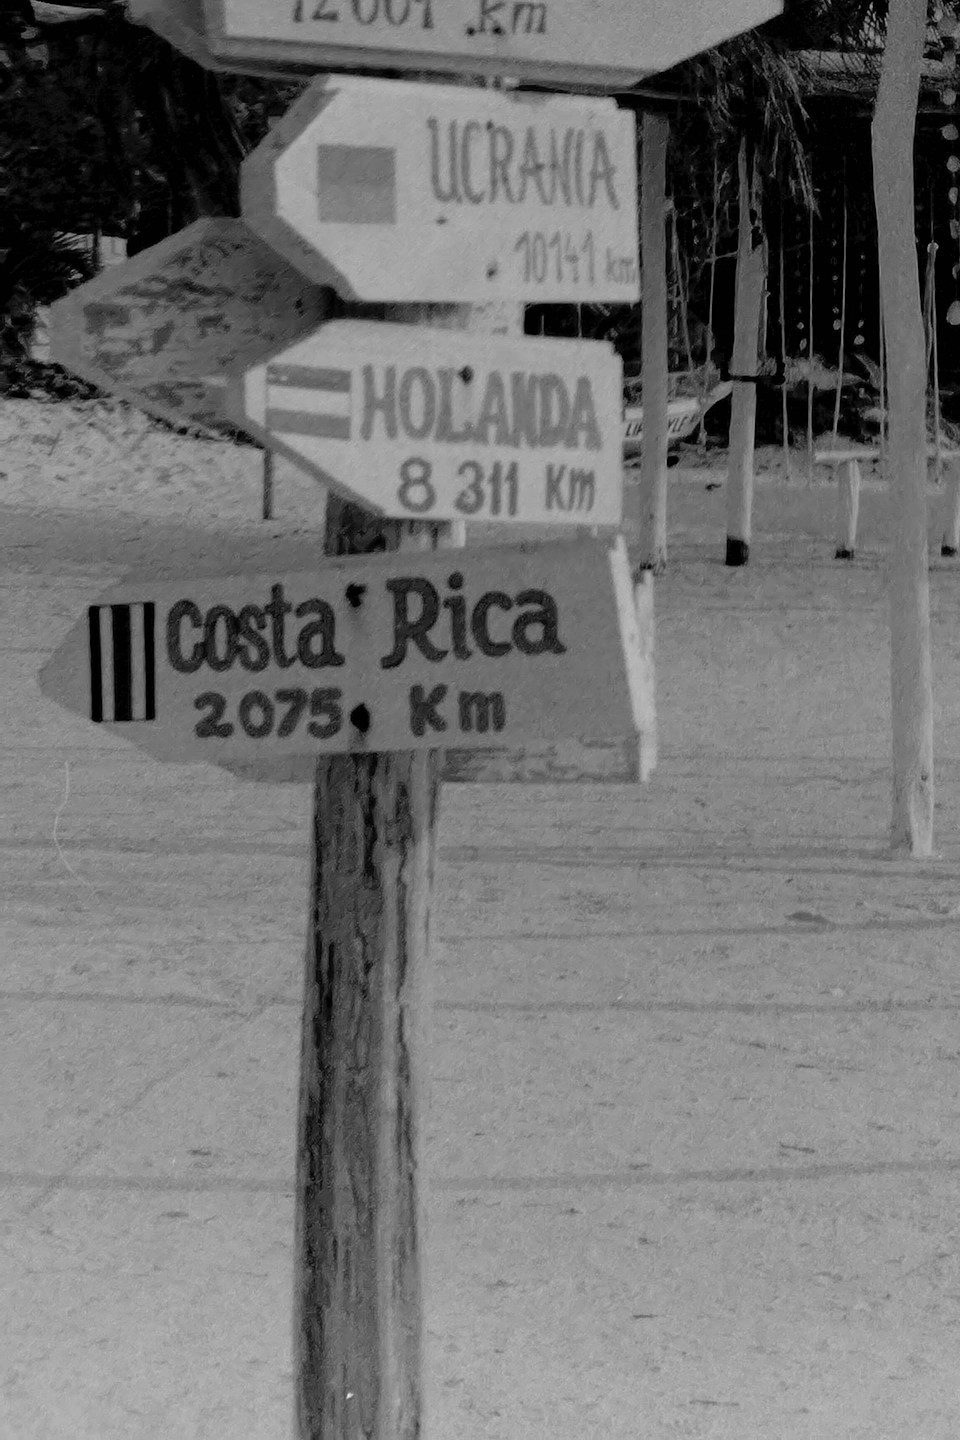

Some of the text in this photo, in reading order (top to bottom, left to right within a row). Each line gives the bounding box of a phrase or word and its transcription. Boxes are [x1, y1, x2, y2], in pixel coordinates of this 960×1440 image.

[426, 115, 620, 210] UCRANIA
[360, 364, 602, 451] HOLANDA
[165, 572, 566, 673] Costa Rica
[193, 686, 343, 740] 2075
